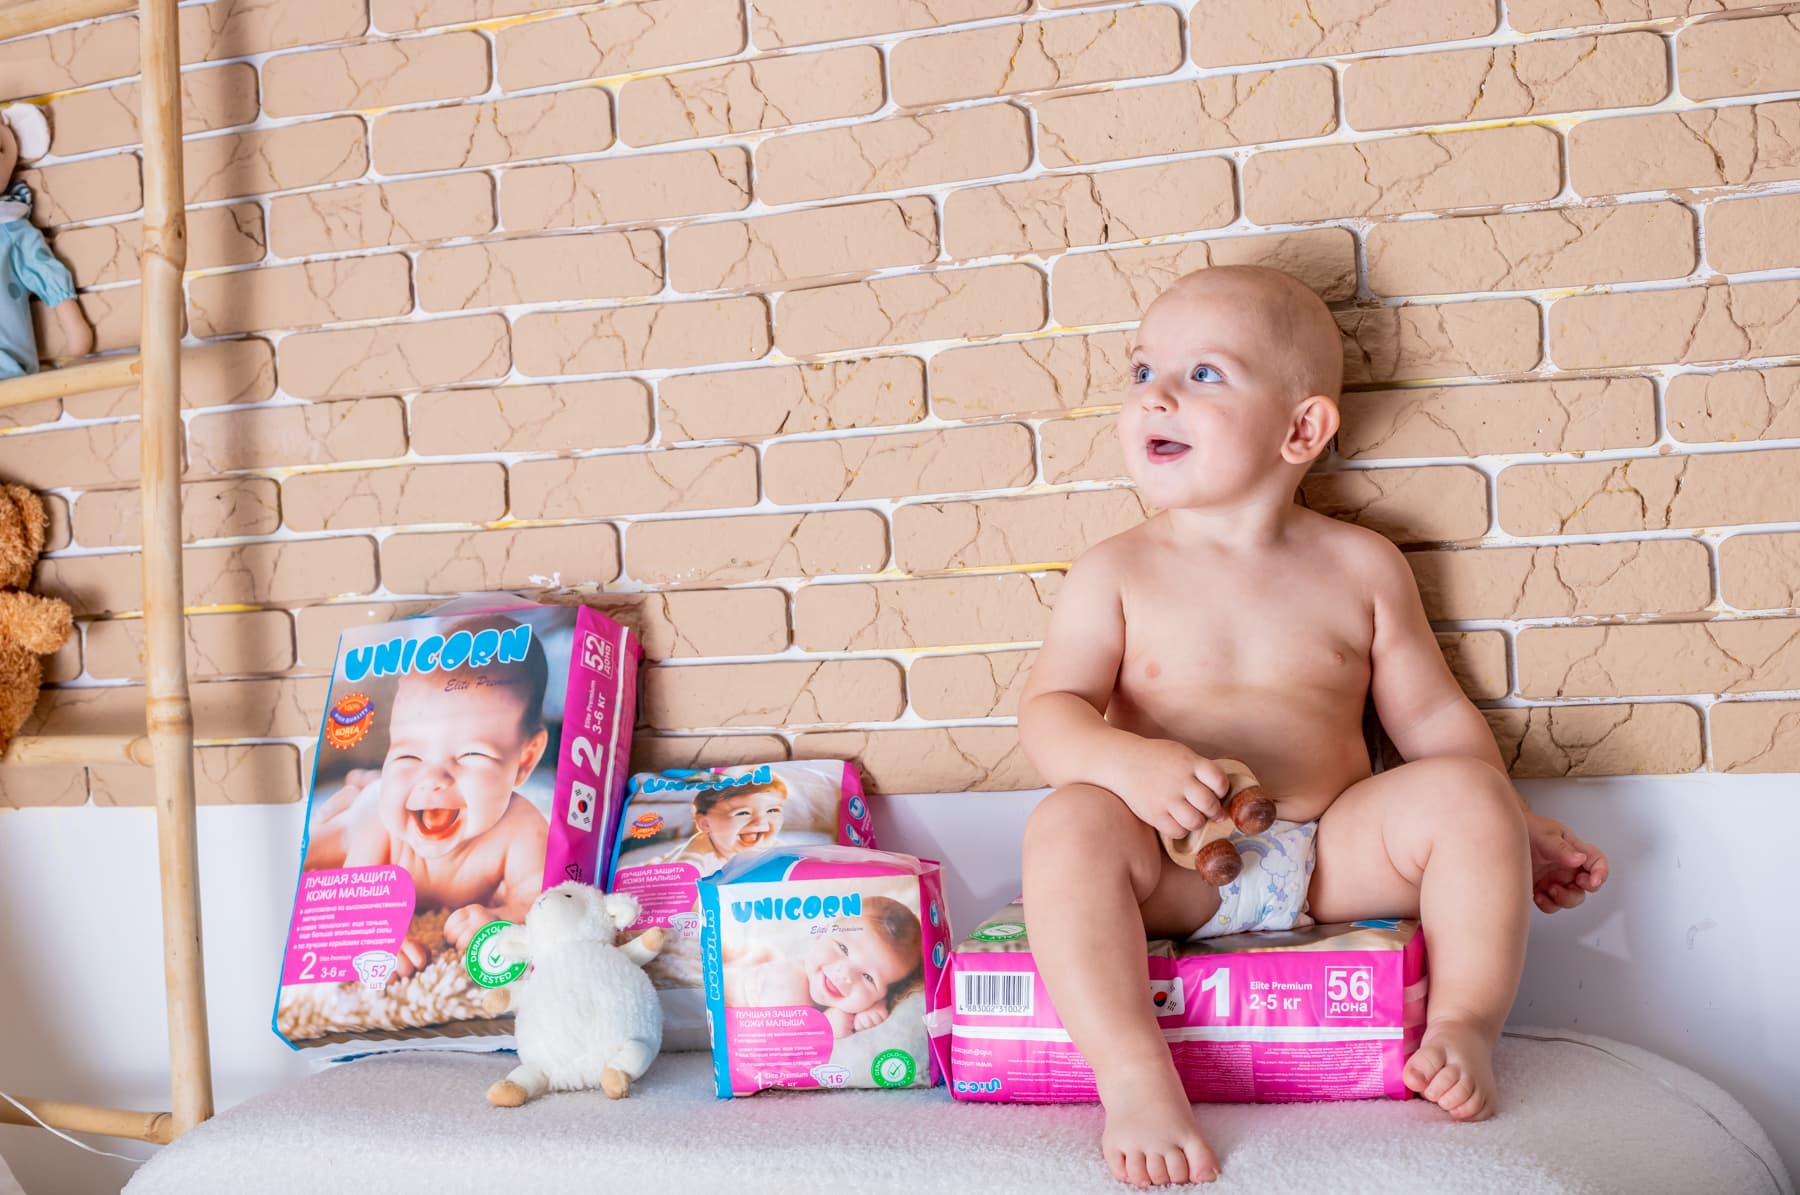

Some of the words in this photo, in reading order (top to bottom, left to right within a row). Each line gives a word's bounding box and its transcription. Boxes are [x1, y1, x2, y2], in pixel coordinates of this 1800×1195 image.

[345, 625, 532, 682] UNICORN
[584, 635, 605, 671] 52
[592, 710, 604, 735] 3-6
[571, 736, 604, 777] 2
[305, 873, 349, 889] ЛУЧШАЯ
[350, 870, 397, 884] ЗАЩИТА
[653, 867, 685, 876] ЗАЩИТА
[305, 888, 337, 902] КОЖИ
[338, 885, 390, 899] МАЛЫША
[731, 892, 862, 923] UNICORN
[684, 920, 698, 929] 20
[298, 951, 317, 980] 2
[320, 966, 337, 979] 3-6
[370, 964, 387, 978] 52
[479, 971, 512, 984] TESTED
[1250, 981, 1270, 990] Elite
[1272, 981, 1312, 990] Premium
[1201, 967, 1230, 1017] 1
[1327, 970, 1371, 1002] 56
[1250, 994, 1277, 1010] 2-5
[1283, 997, 1302, 1010] кг
[1330, 1002, 1368, 1014] дона
[736, 1010, 771, 1019] ЛУЧШАЯ
[773, 1009, 808, 1018] ЗАЩИТА
[829, 1074, 843, 1084] 16
